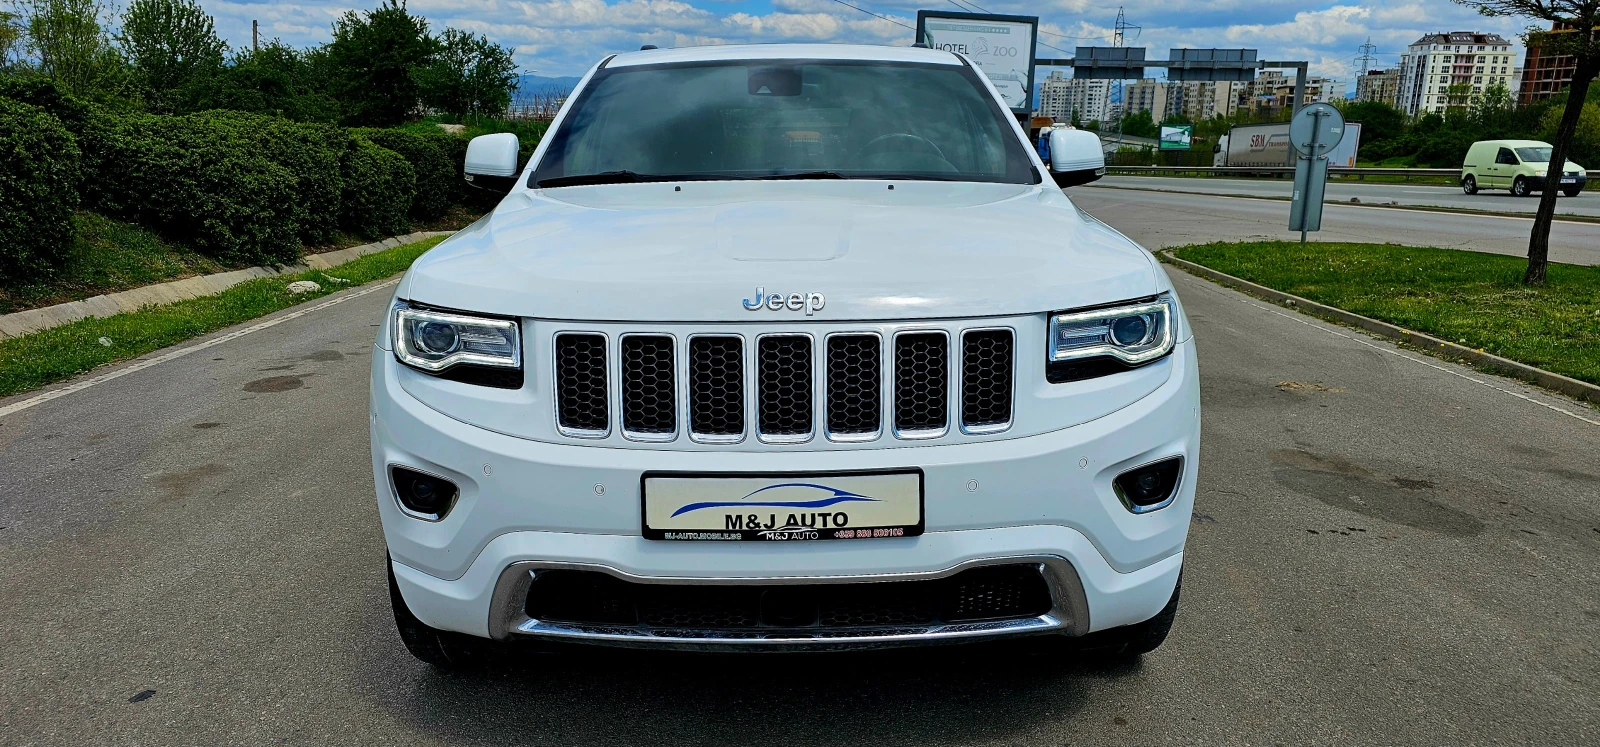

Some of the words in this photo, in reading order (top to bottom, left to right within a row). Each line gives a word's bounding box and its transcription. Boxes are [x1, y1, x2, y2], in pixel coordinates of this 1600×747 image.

[935, 43, 969, 54] HOTEL
[993, 46, 1017, 57] ZOO
[1250, 134, 1265, 148] SBM
[742, 287, 825, 316] Jeep
[725, 514, 776, 530] M&J
[785, 512, 849, 528] AUTO
[766, 532, 788, 540] M&J
[791, 531, 819, 540] AUTO
